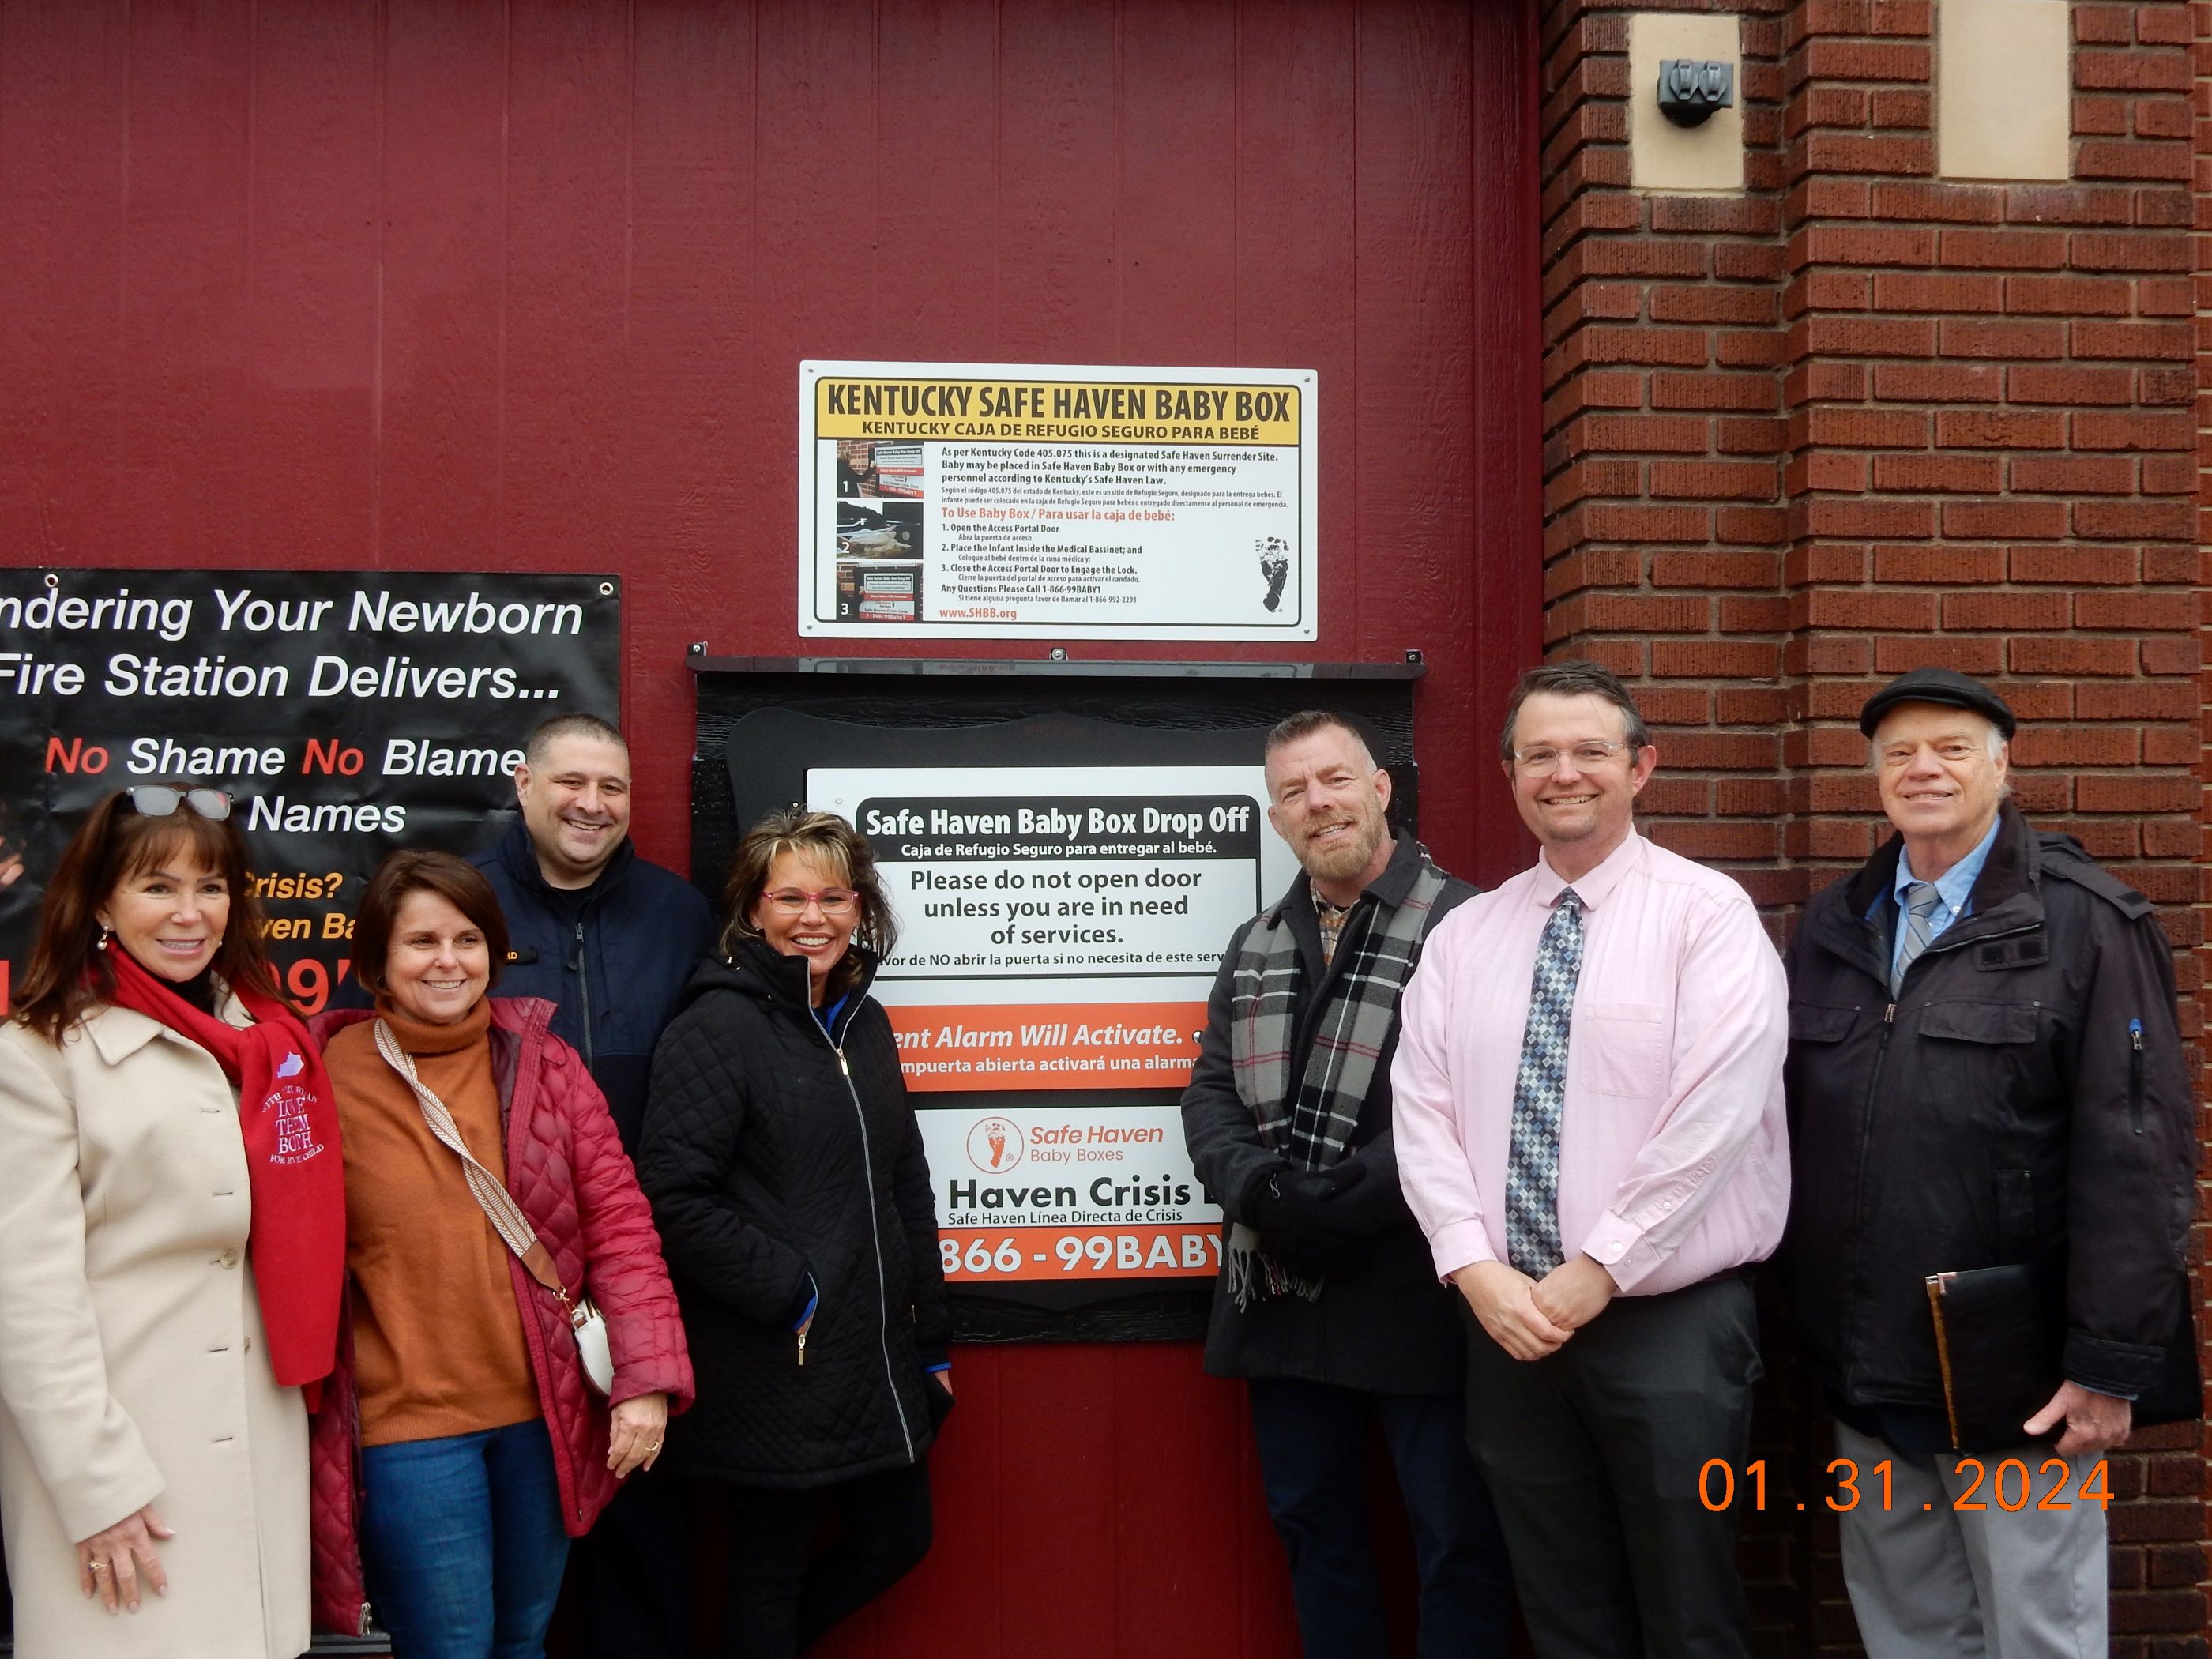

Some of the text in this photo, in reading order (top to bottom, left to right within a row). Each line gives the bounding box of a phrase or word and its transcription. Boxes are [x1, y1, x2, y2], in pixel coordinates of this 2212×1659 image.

[829, 385, 1290, 422] KENTUCKY SAFE HAVEN BABY BOX
[863, 422, 1259, 440] KENTUCKY CAJA DE REFUGIO SEGURO PARA BEBÉ
[942, 447, 952, 456] As
[954, 450, 969, 458] per
[971, 448, 1012, 459] Kentucky
[1014, 449, 1036, 457] Code
[1037, 449, 1072, 458] 405.075
[1074, 449, 1092, 458] this
[1093, 450, 1100, 458] is
[1109, 450, 1159, 461] designated
[1161, 450, 1181, 460] Safe
[1183, 451, 1210, 460] Haven
[1213, 452, 1257, 461] Surrender
[1258, 452, 1278, 461] Site.
[942, 460, 965, 471] Baby
[966, 463, 985, 472] may
[988, 461, 999, 470] be
[1000, 461, 1029, 472] placed
[1031, 461, 1040, 470] in
[1042, 461, 1062, 471] Safe
[1063, 462, 1092, 471] Haven
[1093, 462, 1115, 473] Baby
[1118, 463, 1134, 472] Box
[1147, 463, 1168, 472] with
[1169, 465, 1186, 475] any
[1187, 466, 1236, 476] emergency
[843, 480, 848, 492] 1
[942, 473, 987, 483] personnel
[988, 474, 1031, 485] according
[1094, 475, 1114, 484] Safe
[1115, 476, 1144, 484] Haven
[1146, 476, 1167, 485] Law.
[942, 523, 950, 532] 1.
[950, 523, 972, 533] Open
[988, 524, 1013, 532] Access
[841, 542, 850, 553] 2
[941, 584, 1100, 594] Any Questions Please Call 1-866-99BABY1
[214, 590, 333, 631] Your
[348, 591, 582, 634] Newborn
[841, 603, 849, 615] 3
[939, 608, 1017, 622] www.SHBB.org
[104, 654, 288, 697] Station
[308, 656, 559, 698] Delivers...
[45, 737, 527, 777] No Shame No Blame
[247, 796, 406, 833] Names
[867, 806, 1250, 841] Safe Haven Baby Box Drop Off
[901, 841, 1217, 859] Caja de Refugio Seguro para entregar al bebé.
[912, 868, 1202, 892] Please do not open door
[924, 895, 1188, 921] unless you are in need
[991, 924, 1123, 945] of services.
[909, 954, 926, 966] de
[930, 954, 950, 965] NO
[954, 954, 987, 965] abrir
[990, 954, 1001, 965] la
[1005, 955, 1050, 968] puerta
[1054, 953, 1063, 965] si
[1088, 953, 1142, 964] necesita
[1146, 951, 1163, 963] de
[1166, 953, 1194, 963] este
[935, 1026, 1013, 1048] Alarm
[1021, 1024, 1068, 1047] Will
[1071, 1024, 1183, 1046] Activate.
[976, 1058, 1036, 1072] abierta
[1039, 1056, 1106, 1071] activará
[1110, 1059, 1141, 1070] una
[1030, 1125, 1164, 1145] Safe Haven
[1031, 1149, 1123, 1165] Baby Boxes
[950, 1180, 1077, 1209] Haven
[1089, 1175, 1191, 1206] Crisis
[948, 1209, 1183, 1225] Safe Haven Línea Directa de Crisis
[939, 1239, 1021, 1273] 866
